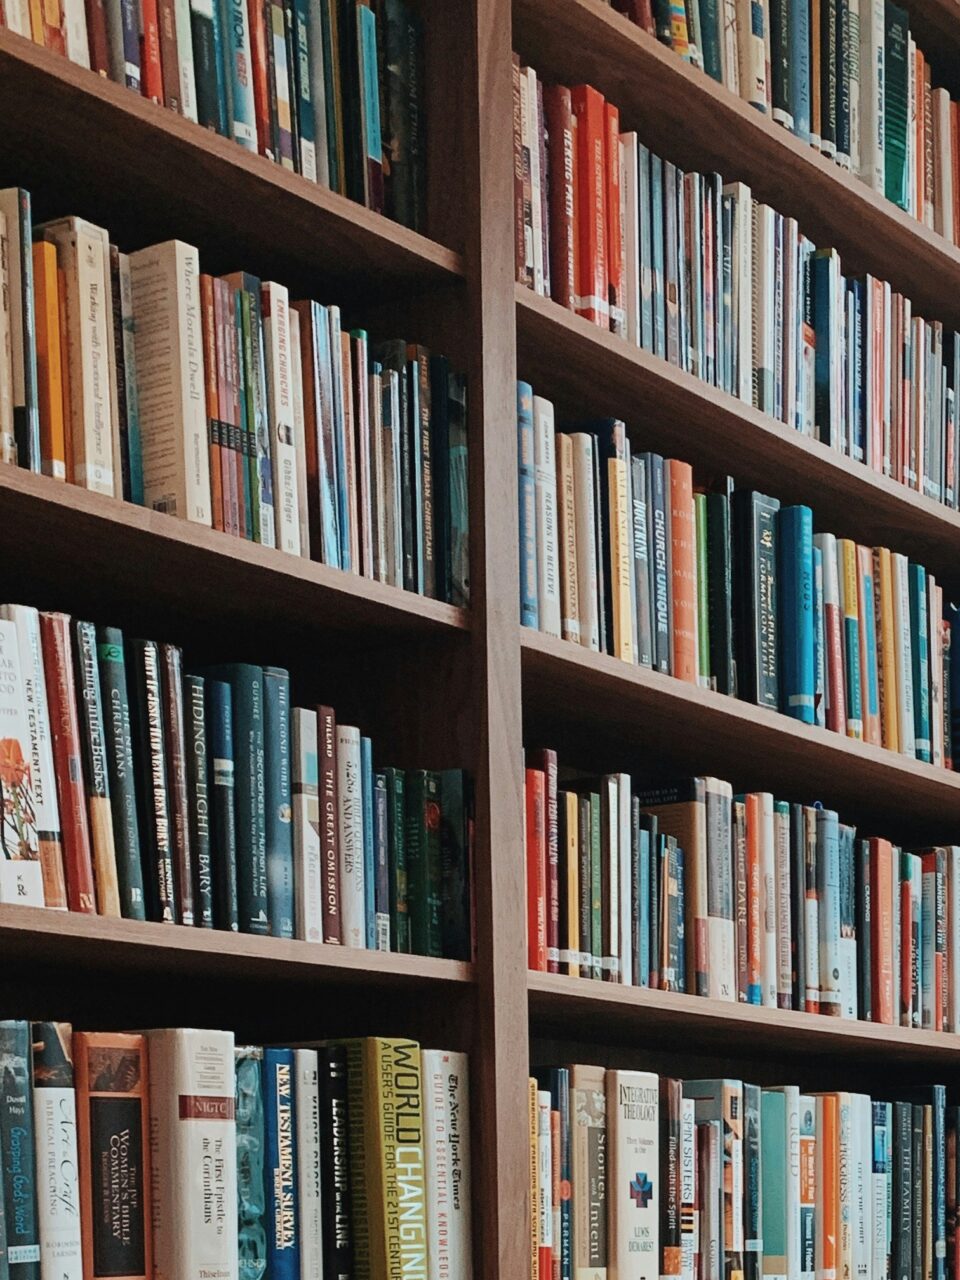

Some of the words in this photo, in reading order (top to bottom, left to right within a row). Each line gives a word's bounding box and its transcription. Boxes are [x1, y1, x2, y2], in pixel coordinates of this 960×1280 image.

[564, 129, 573, 181] HEROIC
[566, 184, 574, 217] PATH
[424, 501, 432, 560] CHRISTIANS
[545, 492, 554, 536] REASONS
[567, 499, 575, 557] EFFECTIVE
[633, 500, 647, 561] DOCTRINE
[546, 541, 555, 552] TO
[655, 510, 666, 570] CHURCH
[547, 556, 556, 595] BELIEVE
[657, 573, 667, 633] UNIQUE
[759, 557, 768, 635] FORMATION
[761, 641, 770, 677] BIBLE
[25, 678, 33, 703] NEW
[82, 655, 98, 700] Thing
[92, 744, 107, 792] Bushes
[111, 688, 126, 778] CHRISTIANS
[191, 685, 206, 755] HIDING
[28, 708, 39, 774] TESTAMENT
[34, 778, 43, 806] TEXT
[280, 758, 288, 797] WORLD
[325, 770, 334, 796] THE
[196, 782, 208, 840] LIGHT
[326, 802, 335, 846] GREAT
[343, 796, 353, 819] AND
[344, 822, 354, 874] ANSWERS
[198, 854, 211, 897] BARY
[259, 876, 267, 897] Life
[327, 849, 336, 915] OMISSION
[381, 1041, 391, 1051] A
[277, 1064, 291, 1098] NEW
[382, 1054, 393, 1099] USER'S
[434, 1074, 445, 1111] GUIDE
[447, 1073, 459, 1100] The
[46, 1099, 57, 1146] BIBLICAL
[194, 1101, 228, 1114] NIGTC
[384, 1102, 395, 1141] GUIDE
[435, 1119, 446, 1132] TO
[448, 1101, 460, 1131] New
[682, 1112, 693, 1142] SPIN
[9, 1127, 28, 1174] Grasping
[202, 1138, 211, 1153] the
[214, 1138, 224, 1155] The
[279, 1103, 293, 1188] TESTAMENT
[385, 1144, 396, 1170] FOR
[448, 1133, 461, 1167] York
[668, 1137, 677, 1157] Filled
[48, 1151, 59, 1216] PREACHING
[110, 1134, 121, 1240] COMMENTARY
[203, 1155, 214, 1224] Corinthians
[214, 1158, 225, 1182] First
[386, 1174, 398, 1198] THE
[436, 1140, 448, 1206] ESSENTIAL
[451, 1168, 463, 1211] Times
[668, 1160, 677, 1184] with
[683, 1147, 693, 1200] SISTERS
[840, 1143, 848, 1202] PROGRESS
[214, 1186, 226, 1222] Epistle
[668, 1187, 677, 1202] the
[903, 1180, 911, 1233] FAMILY
[14, 1205, 29, 1233] Word
[122, 1205, 131, 1246] BIBLE
[216, 1226, 225, 1235] to
[281, 1191, 295, 1249] SURVEY
[387, 1201, 399, 1232] 21ST
[590, 1200, 601, 1260] Intent
[668, 1204, 677, 1230] Spirit
